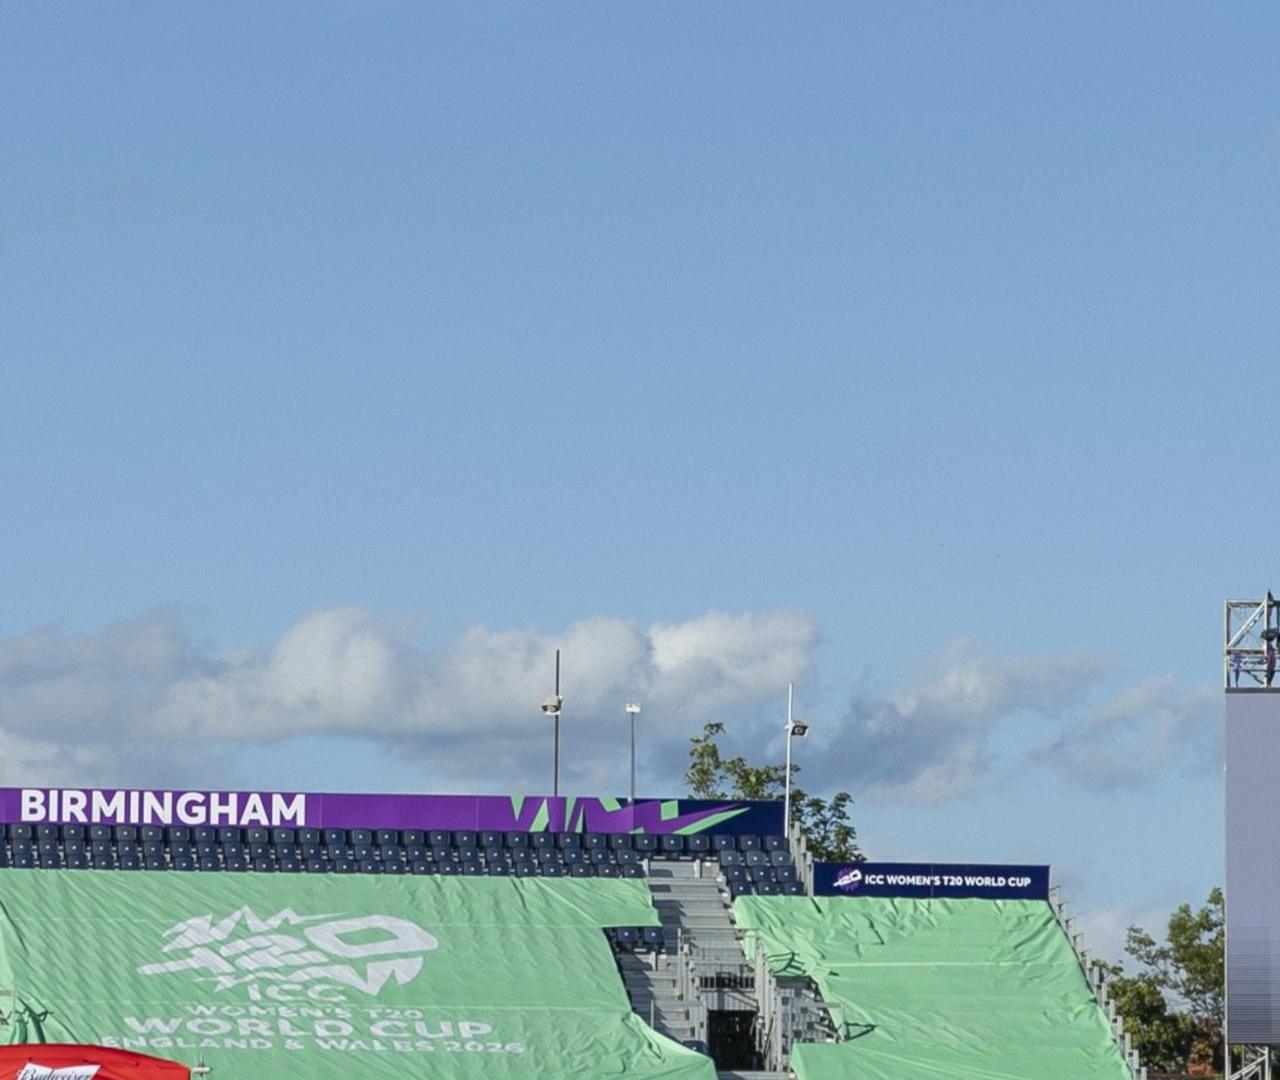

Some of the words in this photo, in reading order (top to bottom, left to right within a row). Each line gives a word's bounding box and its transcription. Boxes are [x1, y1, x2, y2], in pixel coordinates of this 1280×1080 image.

[20, 789, 306, 826] BIRMINGHAM
[865, 874, 884, 885] ICC
[887, 875, 941, 886] WOMEN'S
[943, 876, 963, 886] T20
[965, 876, 1006, 887] WORLD
[1008, 877, 1032, 887] CUP
[247, 983, 348, 1002] ICC
[185, 1004, 353, 1019] WOMEN'S
[365, 1007, 424, 1020] T20
[123, 1017, 354, 1038] WORLD
[369, 1020, 494, 1039] CUP
[100, 1036, 274, 1050] ENGLAND
[284, 1037, 305, 1051] &
[315, 1038, 435, 1053] WALES
[444, 1041, 526, 1055] 2026
